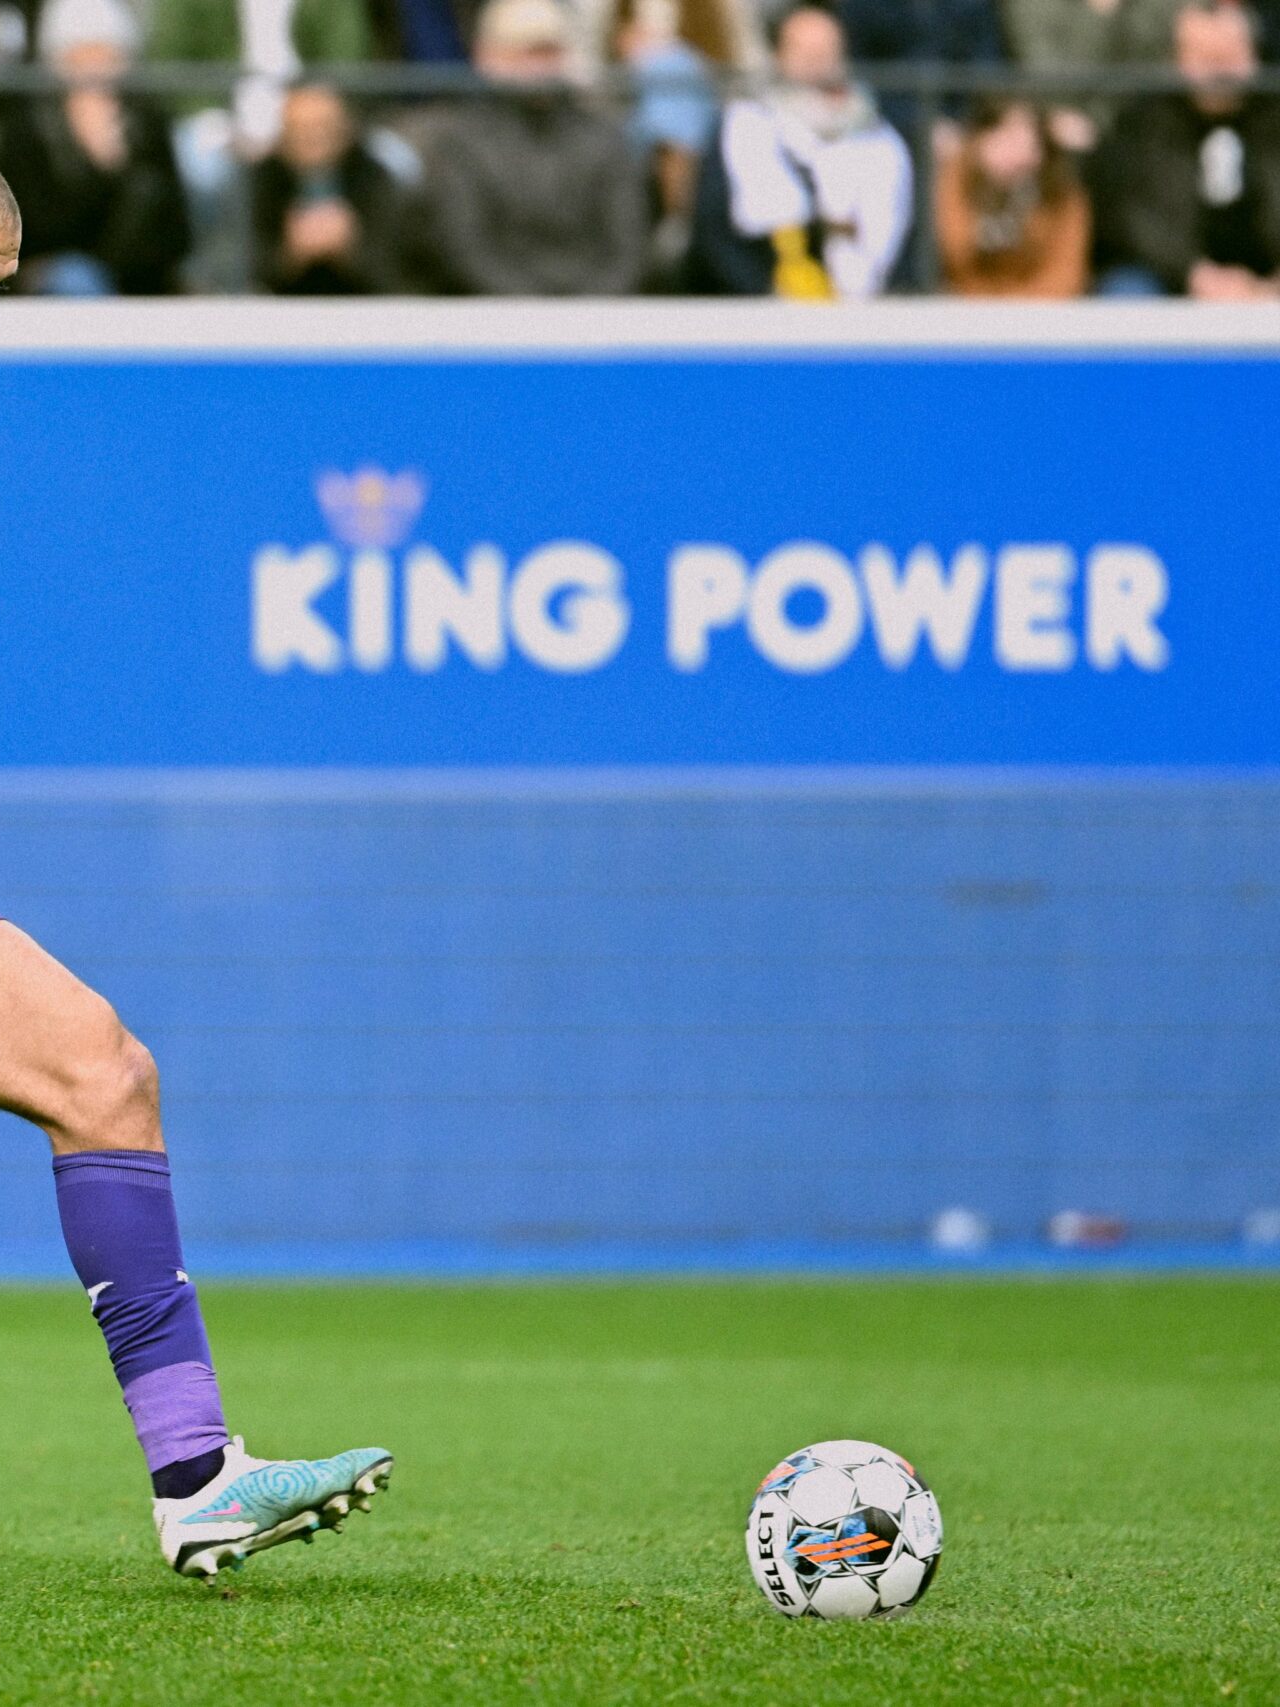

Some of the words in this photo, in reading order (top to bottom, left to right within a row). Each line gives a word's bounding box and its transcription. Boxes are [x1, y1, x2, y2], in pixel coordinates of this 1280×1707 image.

[251, 540, 631, 674] KING
[666, 540, 1171, 674] POWER
[757, 1510, 796, 1607] SELECT
